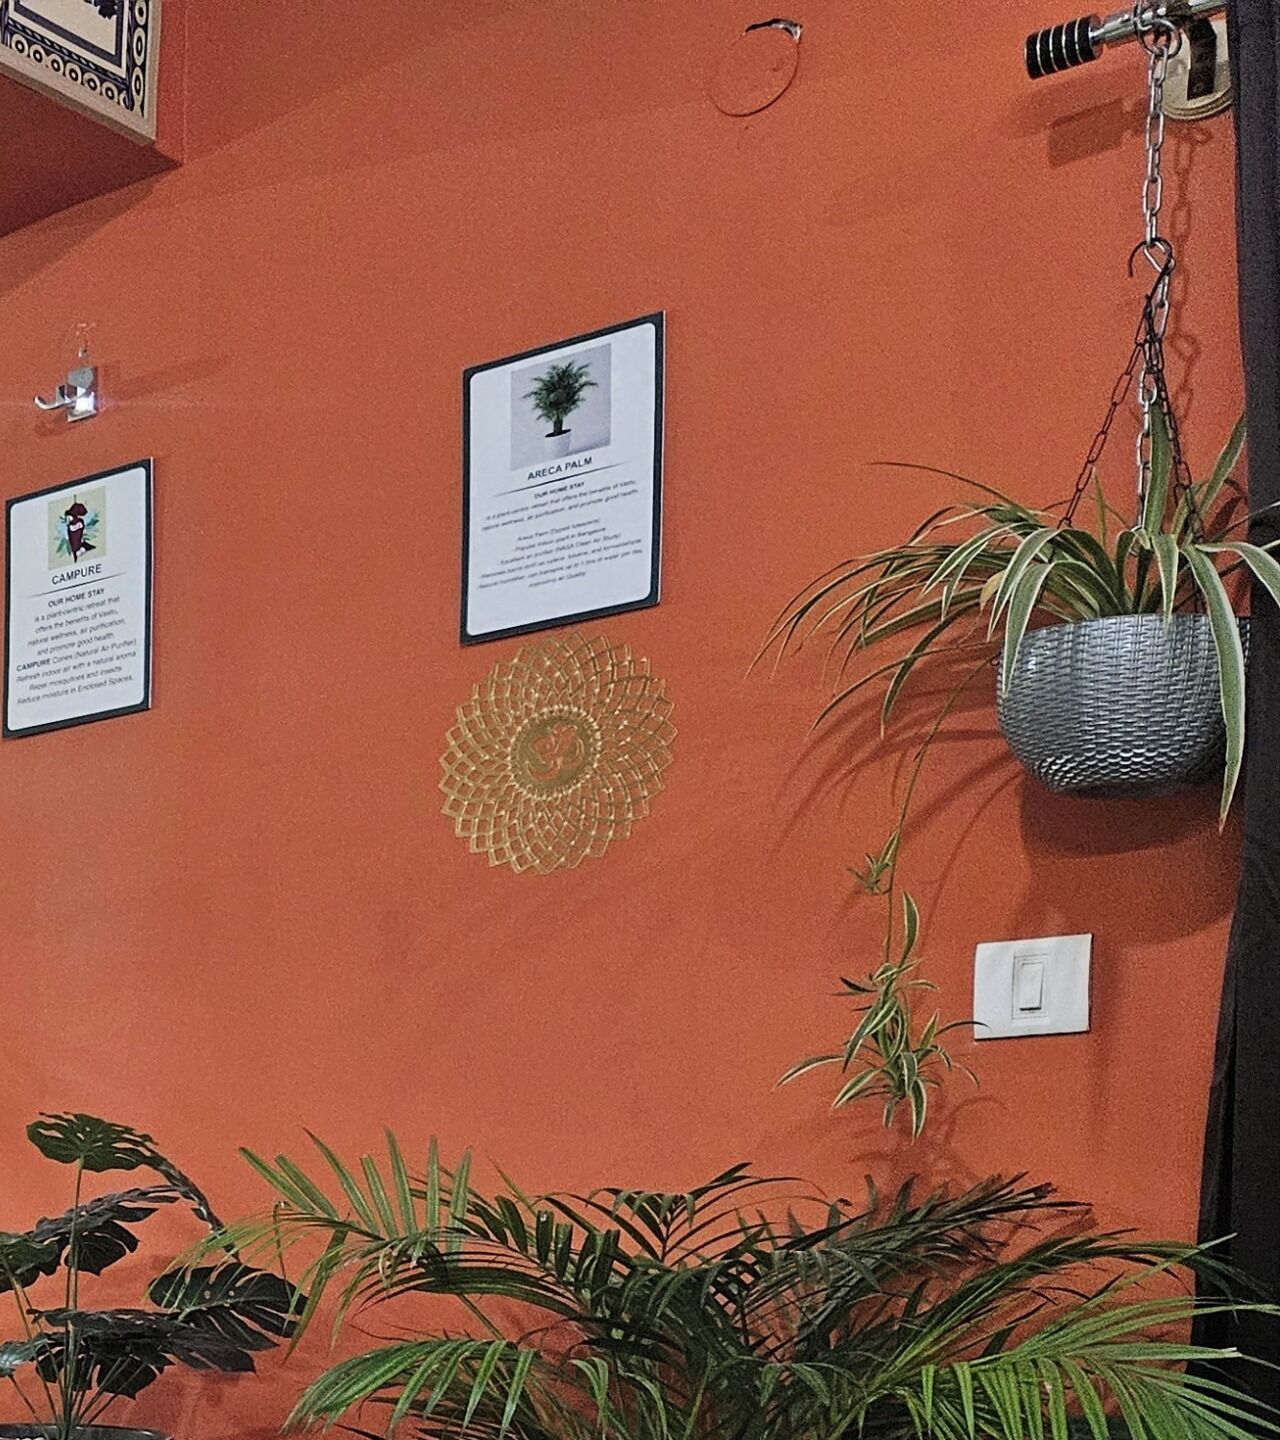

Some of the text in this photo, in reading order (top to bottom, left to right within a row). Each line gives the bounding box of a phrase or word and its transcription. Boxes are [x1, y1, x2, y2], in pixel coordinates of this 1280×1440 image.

[527, 457, 592, 481] ARECA PALM
[52, 563, 102, 585] CAMPURE
[48, 588, 104, 608] OUR HOME STAY
[16, 658, 50, 672] CAMPURE
